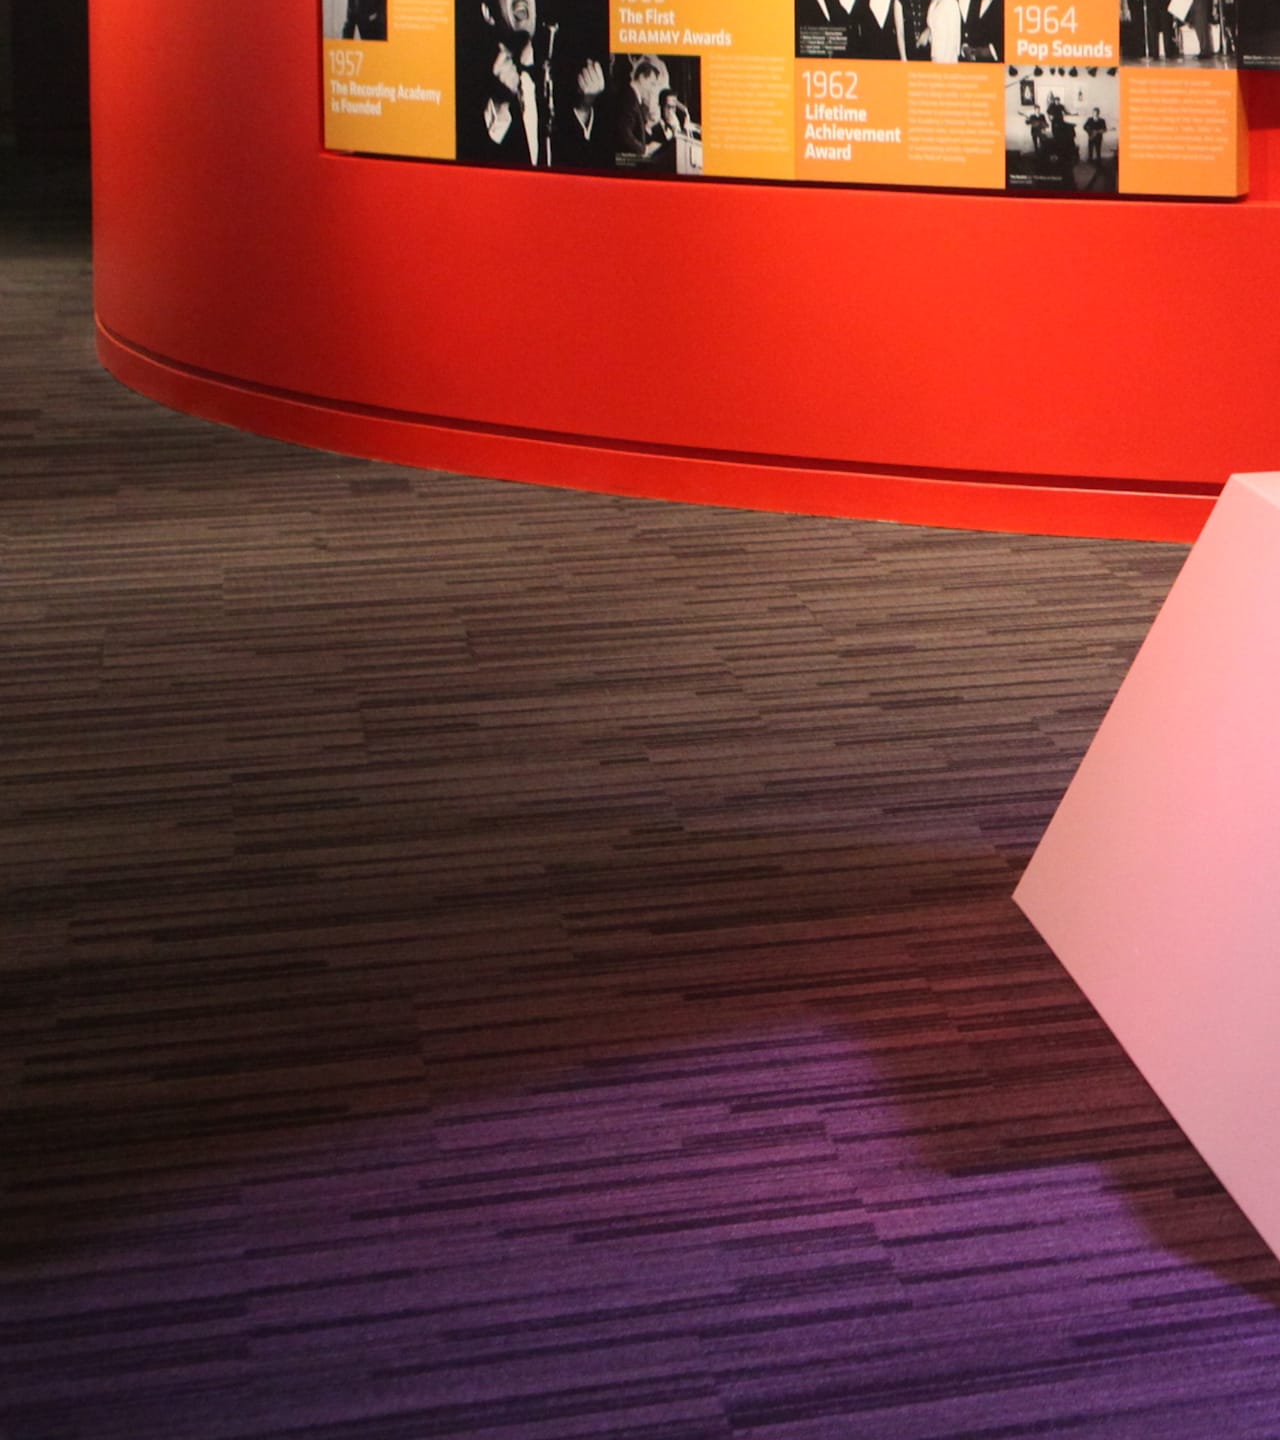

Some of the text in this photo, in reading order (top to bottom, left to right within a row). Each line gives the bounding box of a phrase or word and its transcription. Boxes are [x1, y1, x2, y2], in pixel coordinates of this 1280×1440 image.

[619, 9, 675, 26] The First
[1014, 6, 1078, 34] 1964
[619, 28, 732, 46] GRAMMY Awards
[1017, 40, 1113, 60] Pop Sounds
[329, 50, 364, 76] 1957
[330, 80, 442, 105] The Recording Academy
[802, 71, 858, 100] 1962
[341, 99, 382, 116] Founded
[805, 104, 867, 122] Lifetime
[805, 125, 901, 143] Achievement
[805, 144, 852, 160] Award
